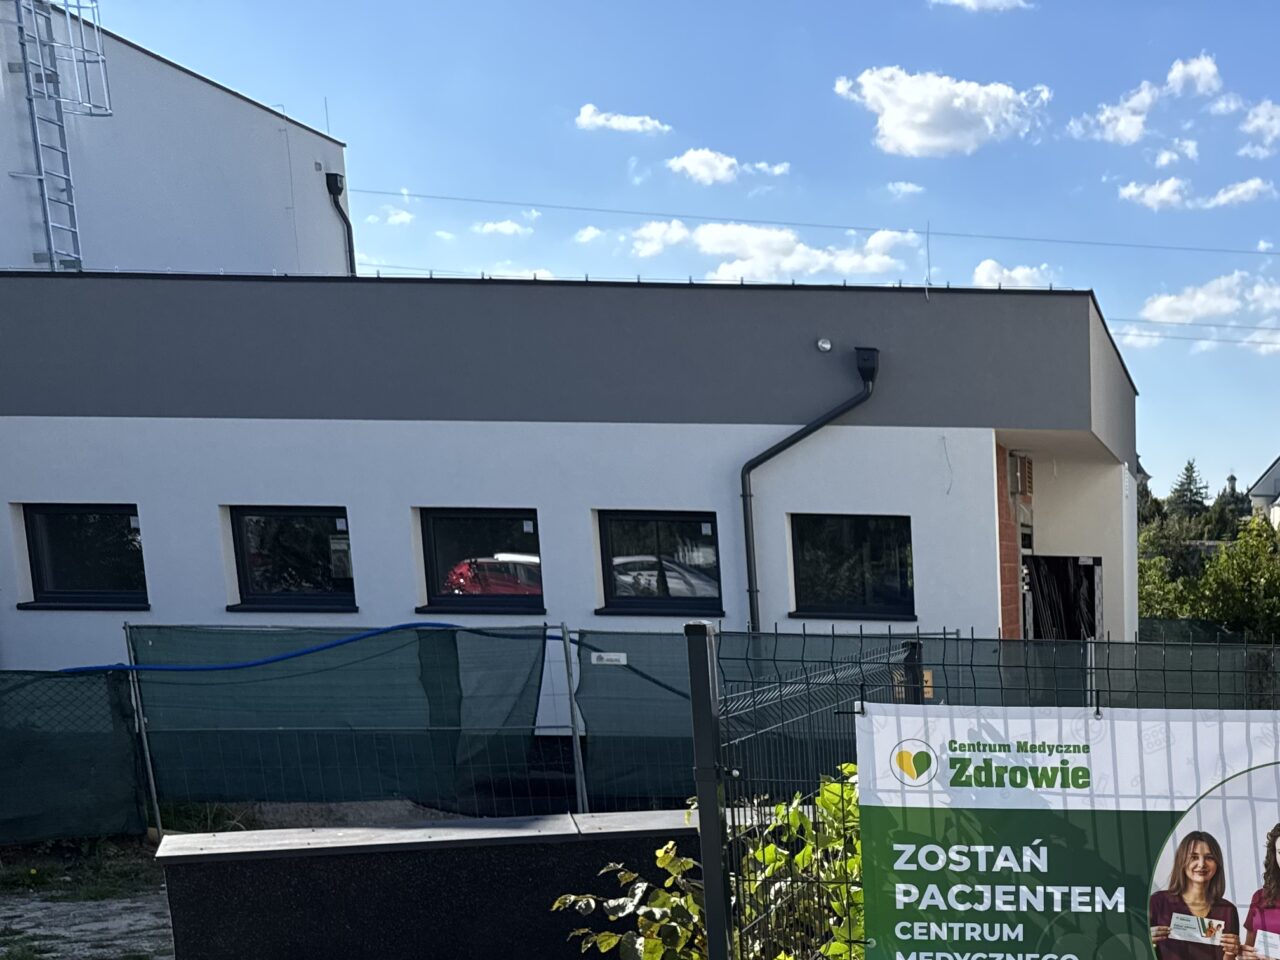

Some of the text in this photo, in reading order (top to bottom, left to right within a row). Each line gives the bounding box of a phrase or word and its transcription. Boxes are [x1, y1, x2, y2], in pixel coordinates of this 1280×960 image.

[948, 739, 1090, 755] Centrum Medyczne
[949, 758, 1091, 789] Zdrowie
[892, 838, 1048, 873] ZOSTAŃ
[895, 884, 1125, 913] PACJENTEM
[894, 922, 1024, 942] CENTRUM
